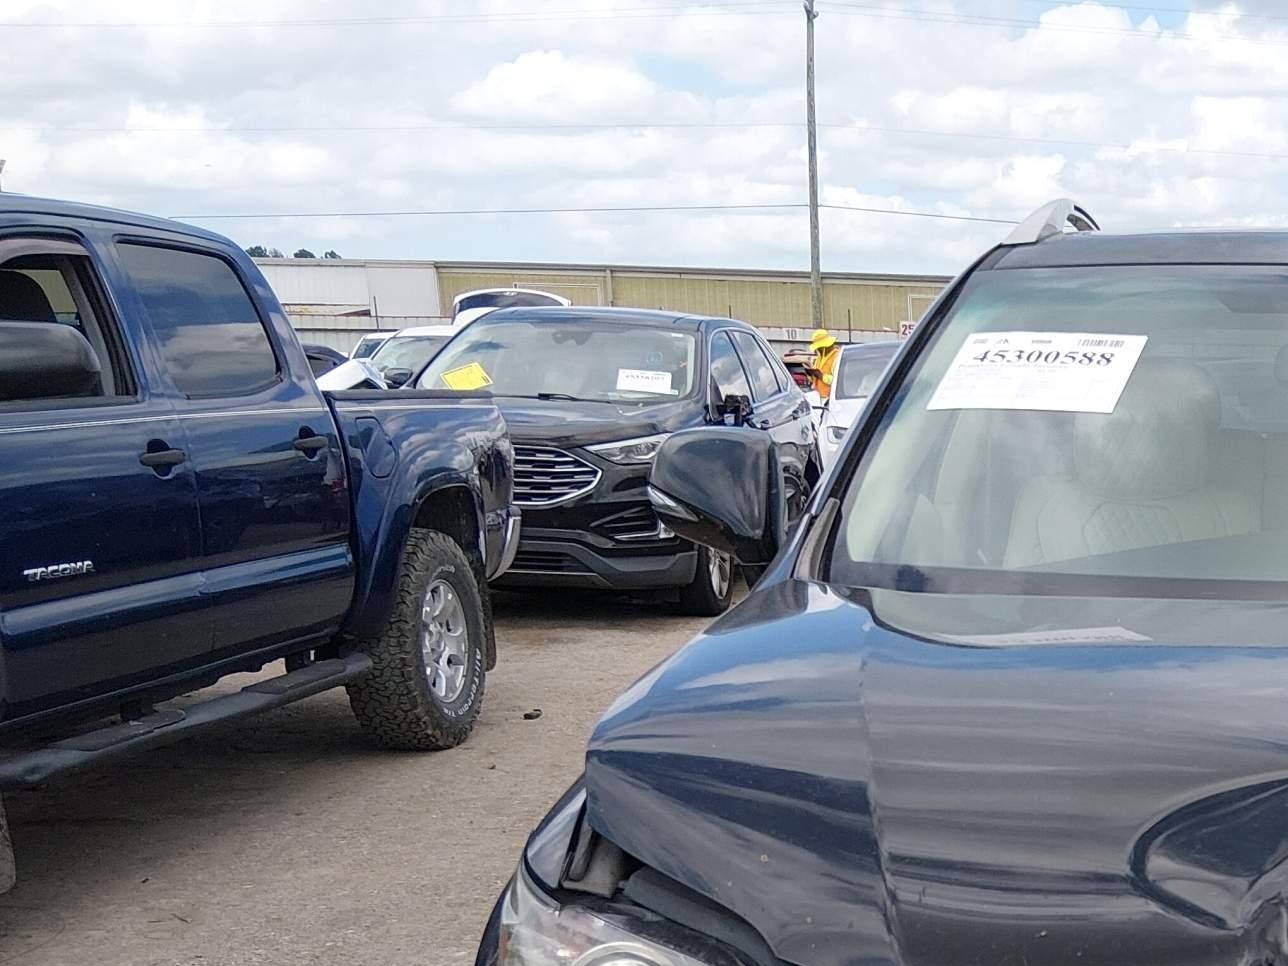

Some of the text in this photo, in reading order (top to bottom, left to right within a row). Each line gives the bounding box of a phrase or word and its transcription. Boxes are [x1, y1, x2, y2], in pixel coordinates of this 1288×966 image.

[785, 328, 798, 341] 10
[972, 349, 1115, 367] 45300588
[23, 560, 96, 582] TACOMA
